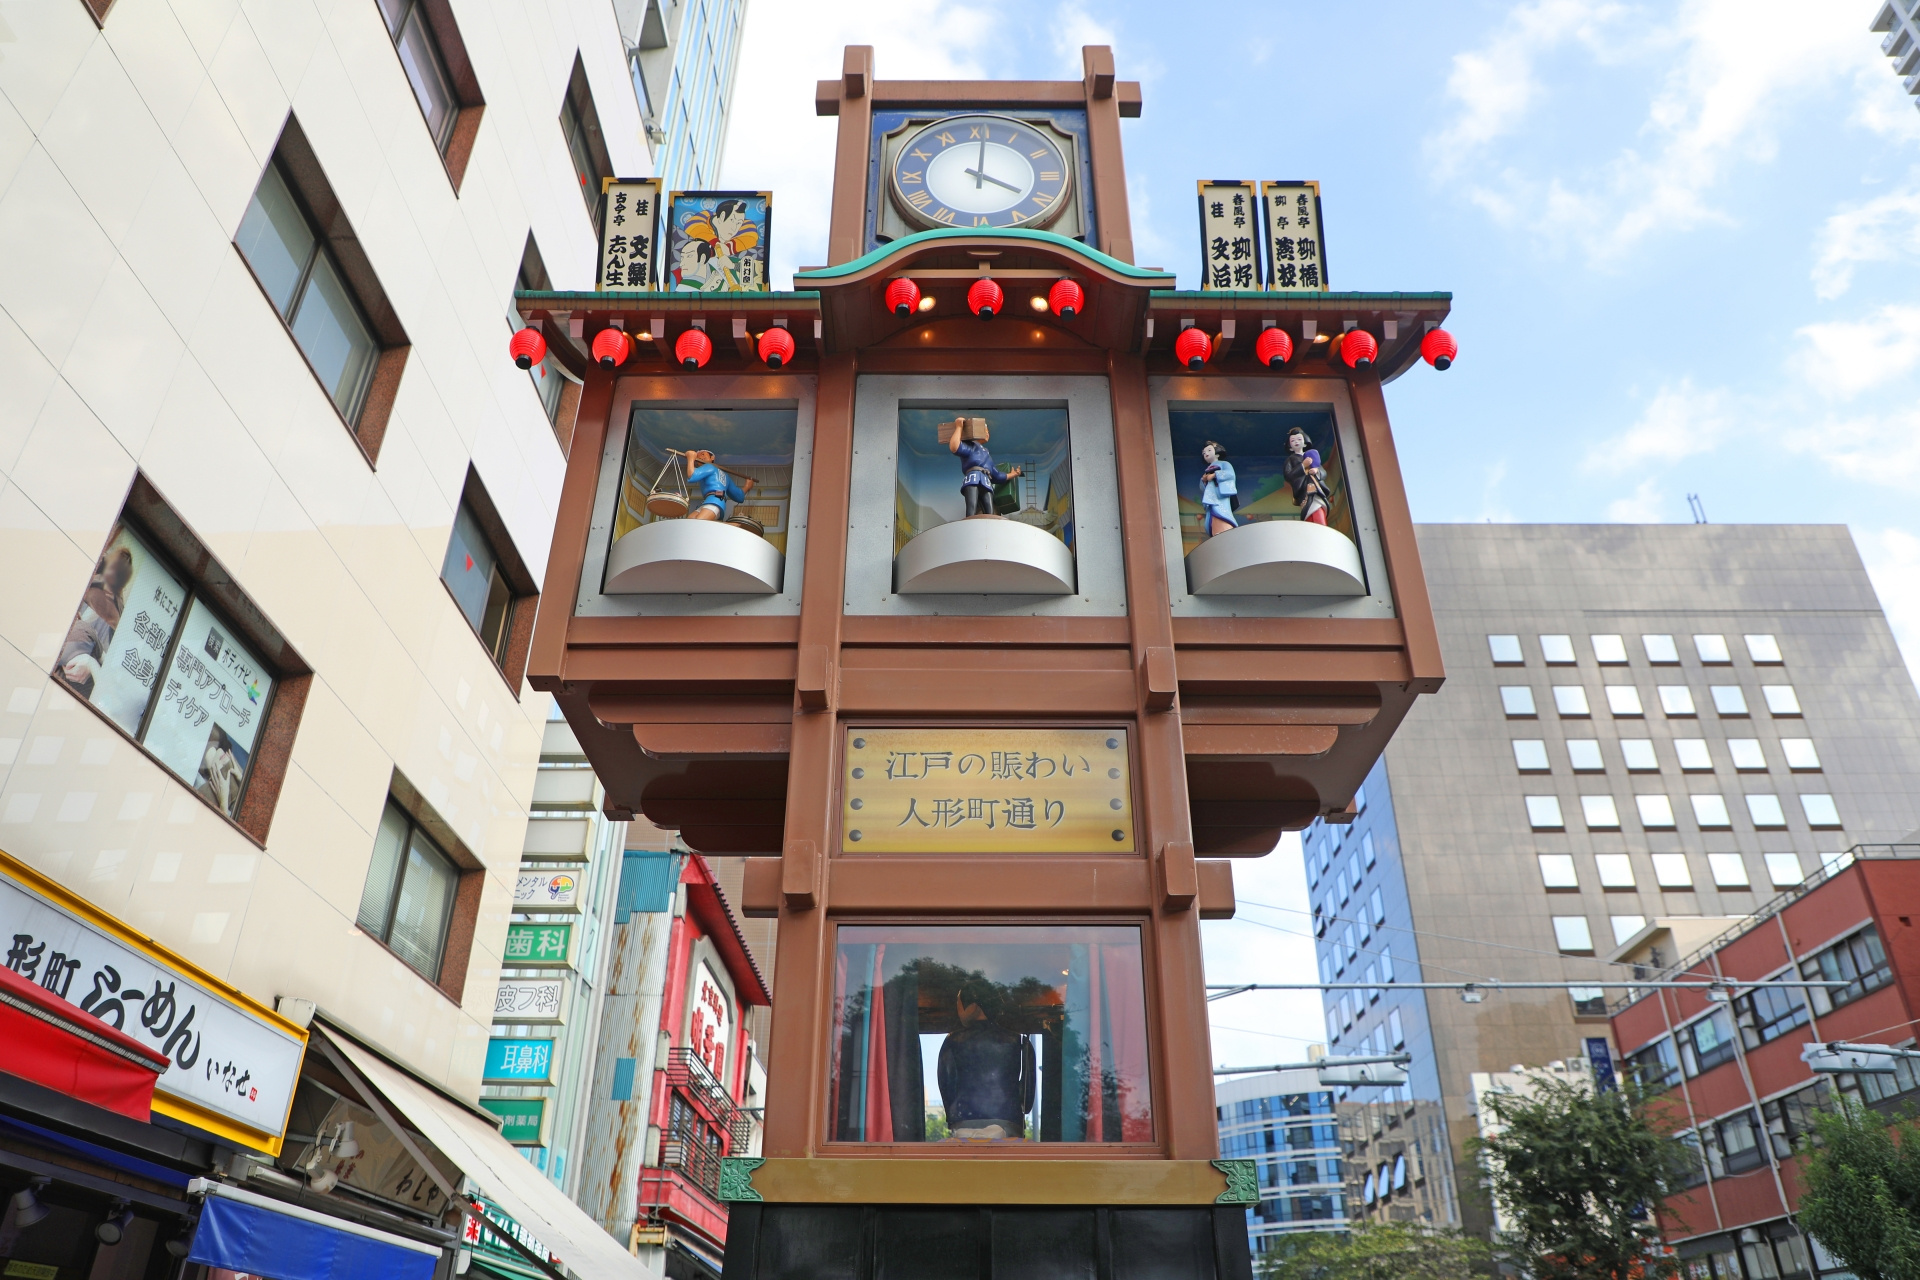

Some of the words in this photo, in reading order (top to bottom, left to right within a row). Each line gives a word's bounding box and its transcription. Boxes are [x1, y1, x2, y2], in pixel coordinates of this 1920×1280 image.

[970, 126, 990, 139] XI
[121, 647, 159, 691] 全身
[885, 750, 1091, 781] 江戸の賑わい
[896, 796, 1065, 830] 人形町通り
[505, 929, 566, 958] 歯科
[495, 984, 559, 1013] 皮フ科
[500, 1045, 549, 1074] 耳鼻科
[206, 1057, 251, 1097] いなせ
